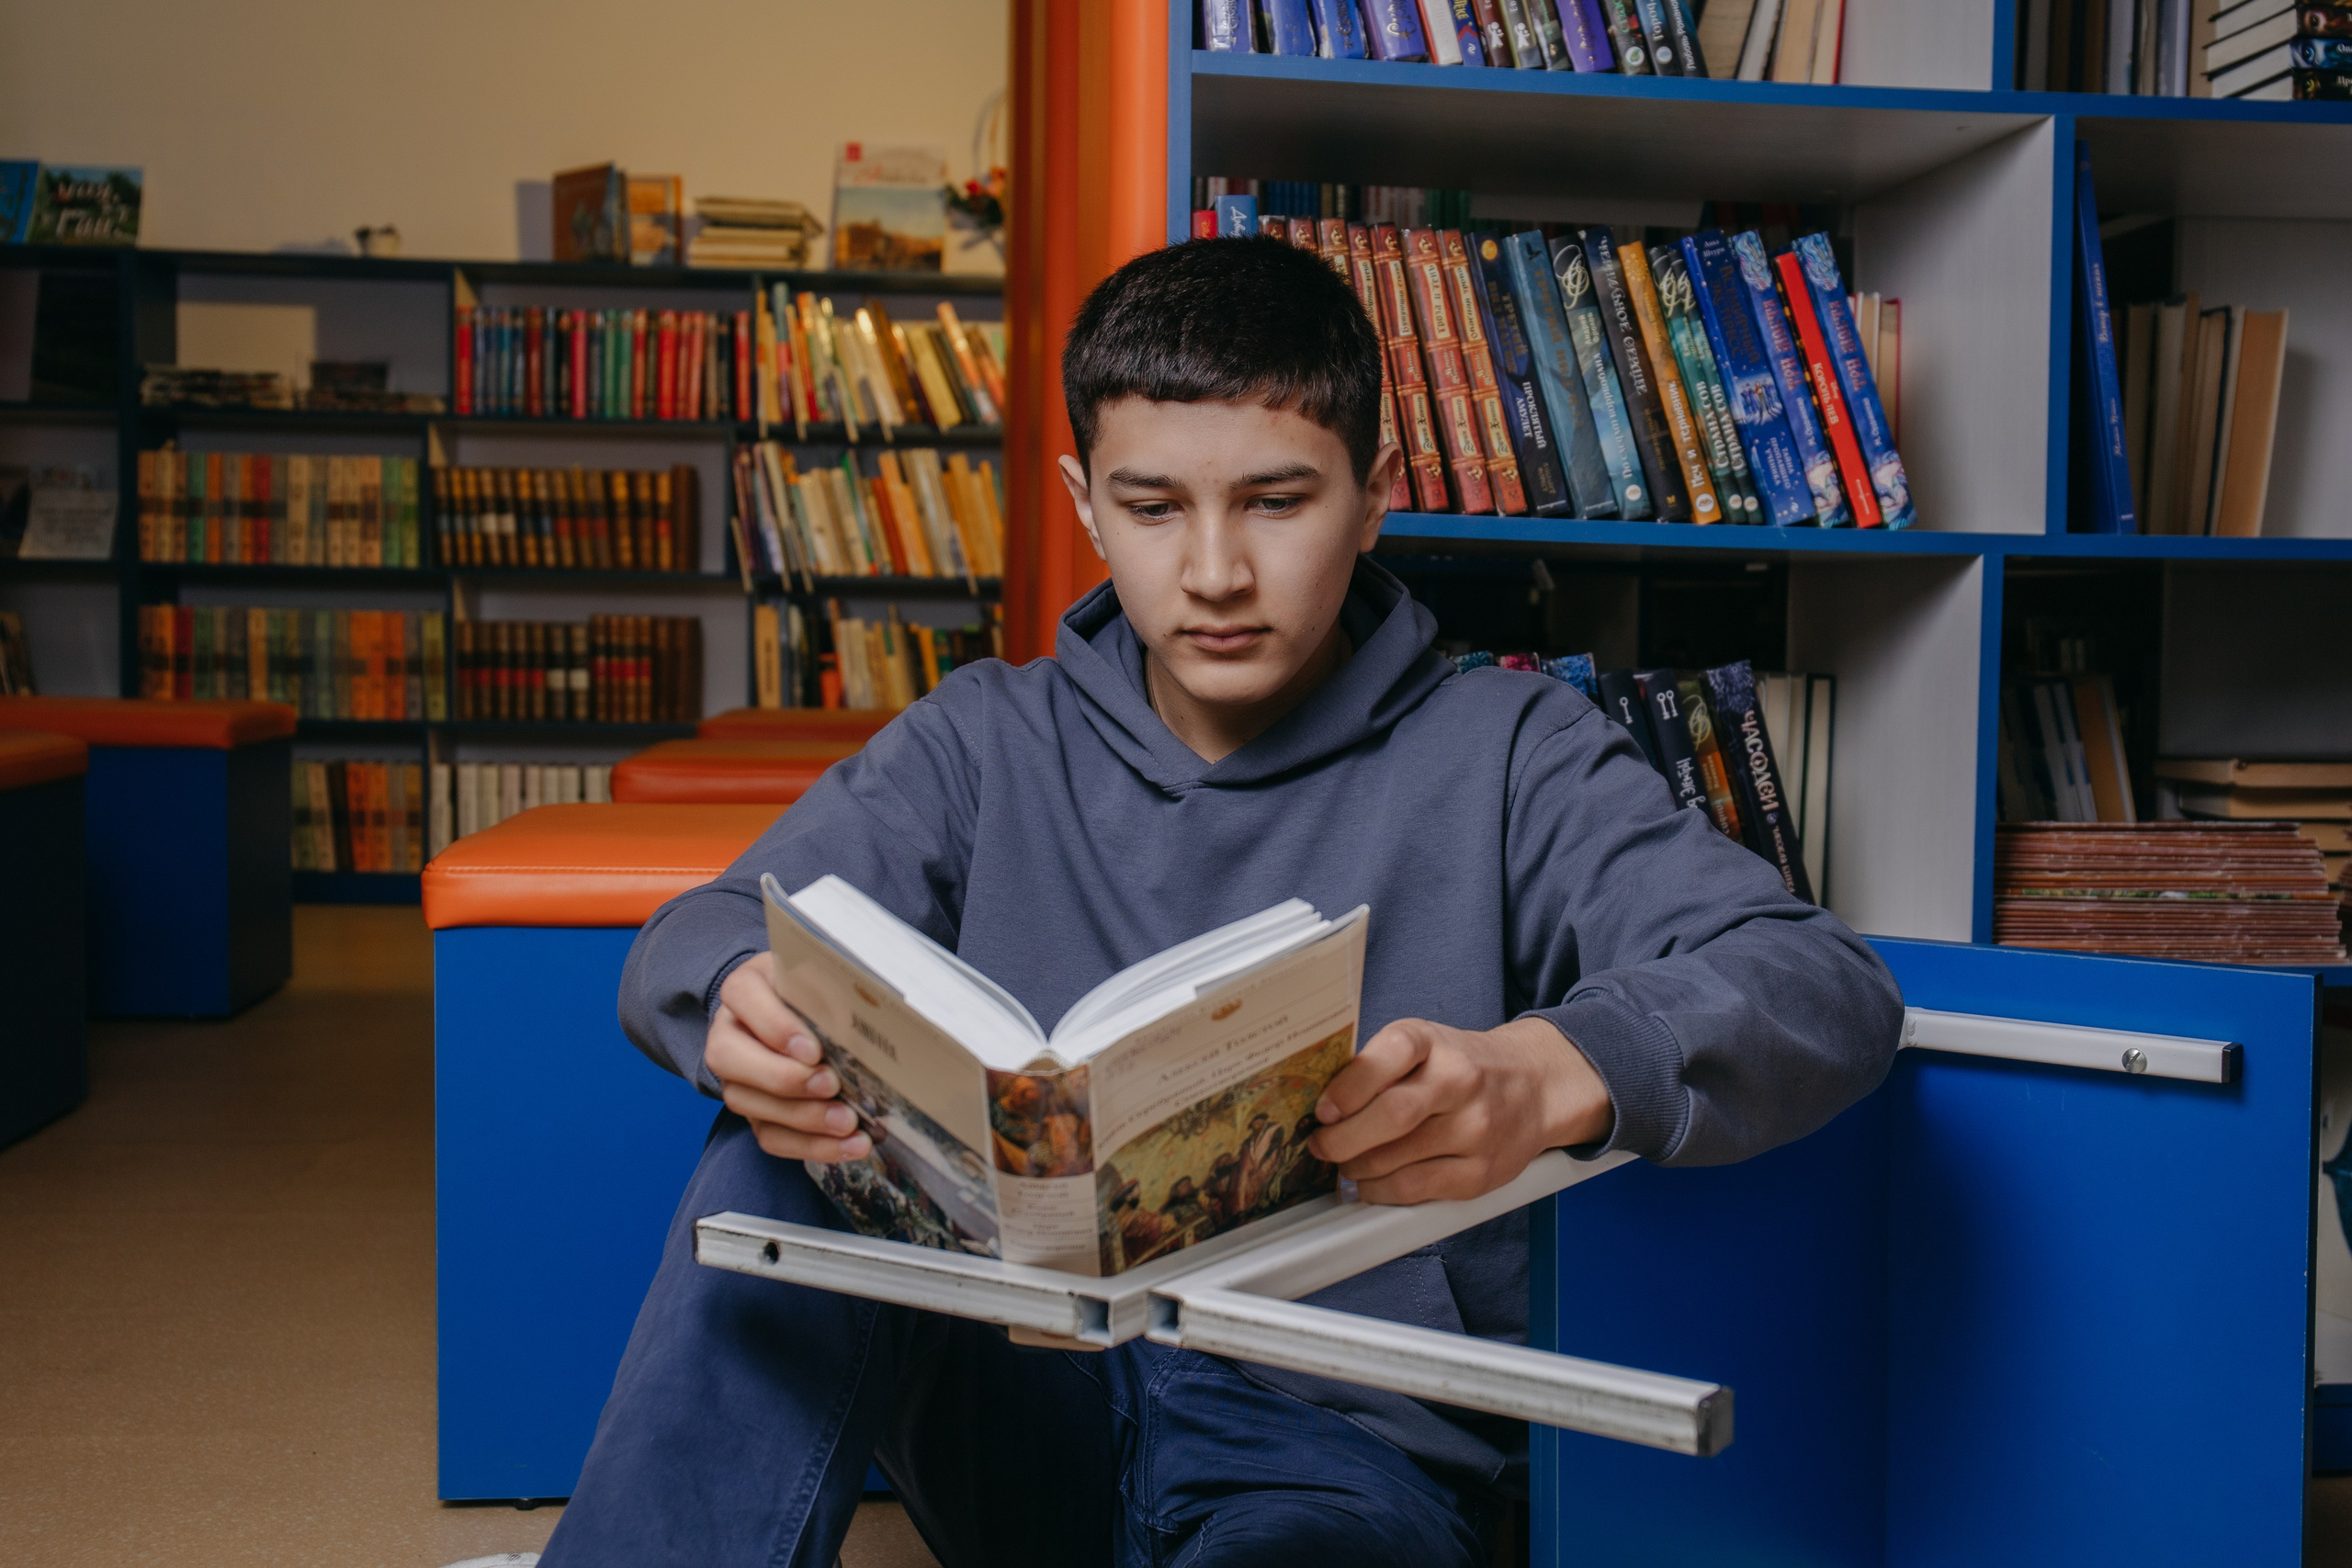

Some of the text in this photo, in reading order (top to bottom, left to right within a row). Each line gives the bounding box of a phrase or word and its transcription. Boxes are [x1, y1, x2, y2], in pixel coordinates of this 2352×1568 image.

[1667, 0, 1698, 70] Любовь Романо
[1396, 289, 1410, 333] Бушующая
[1432, 304, 1446, 333] Гроза
[1456, 266, 1479, 339] Опасная тропа
[1502, 292, 1529, 355] ТРЕТИЙ
[1577, 313, 1593, 344] Андрей
[1585, 311, 1600, 343] Фролов
[1600, 236, 1647, 395] ЧЕРНИЛЬНОЕ СЕРДЦЕ
[1678, 333, 1691, 356] Елена
[1515, 397, 1532, 438] АМУЛЕТ
[1521, 382, 1547, 448] ПРОКЛЯТЫЙ
[1813, 363, 1839, 424] КОРОЛЬ ЛЕВ
[1413, 395, 1433, 450] Эрин Хантер
[1452, 397, 1475, 453] Эрин Хантер
[1485, 399, 1509, 454] Эрин Хантер
[1611, 419, 1629, 460] следам
[1667, 381, 1705, 487] Меч и терновник
[1620, 461, 1634, 478] По
[1764, 447, 1781, 486] УЧЕНИКА
[1769, 436, 1792, 490] ПРОПАВШЕГО
[1781, 446, 1795, 473] ТАЙНА
[1741, 710, 1780, 812] ЧАСОДЕИ
